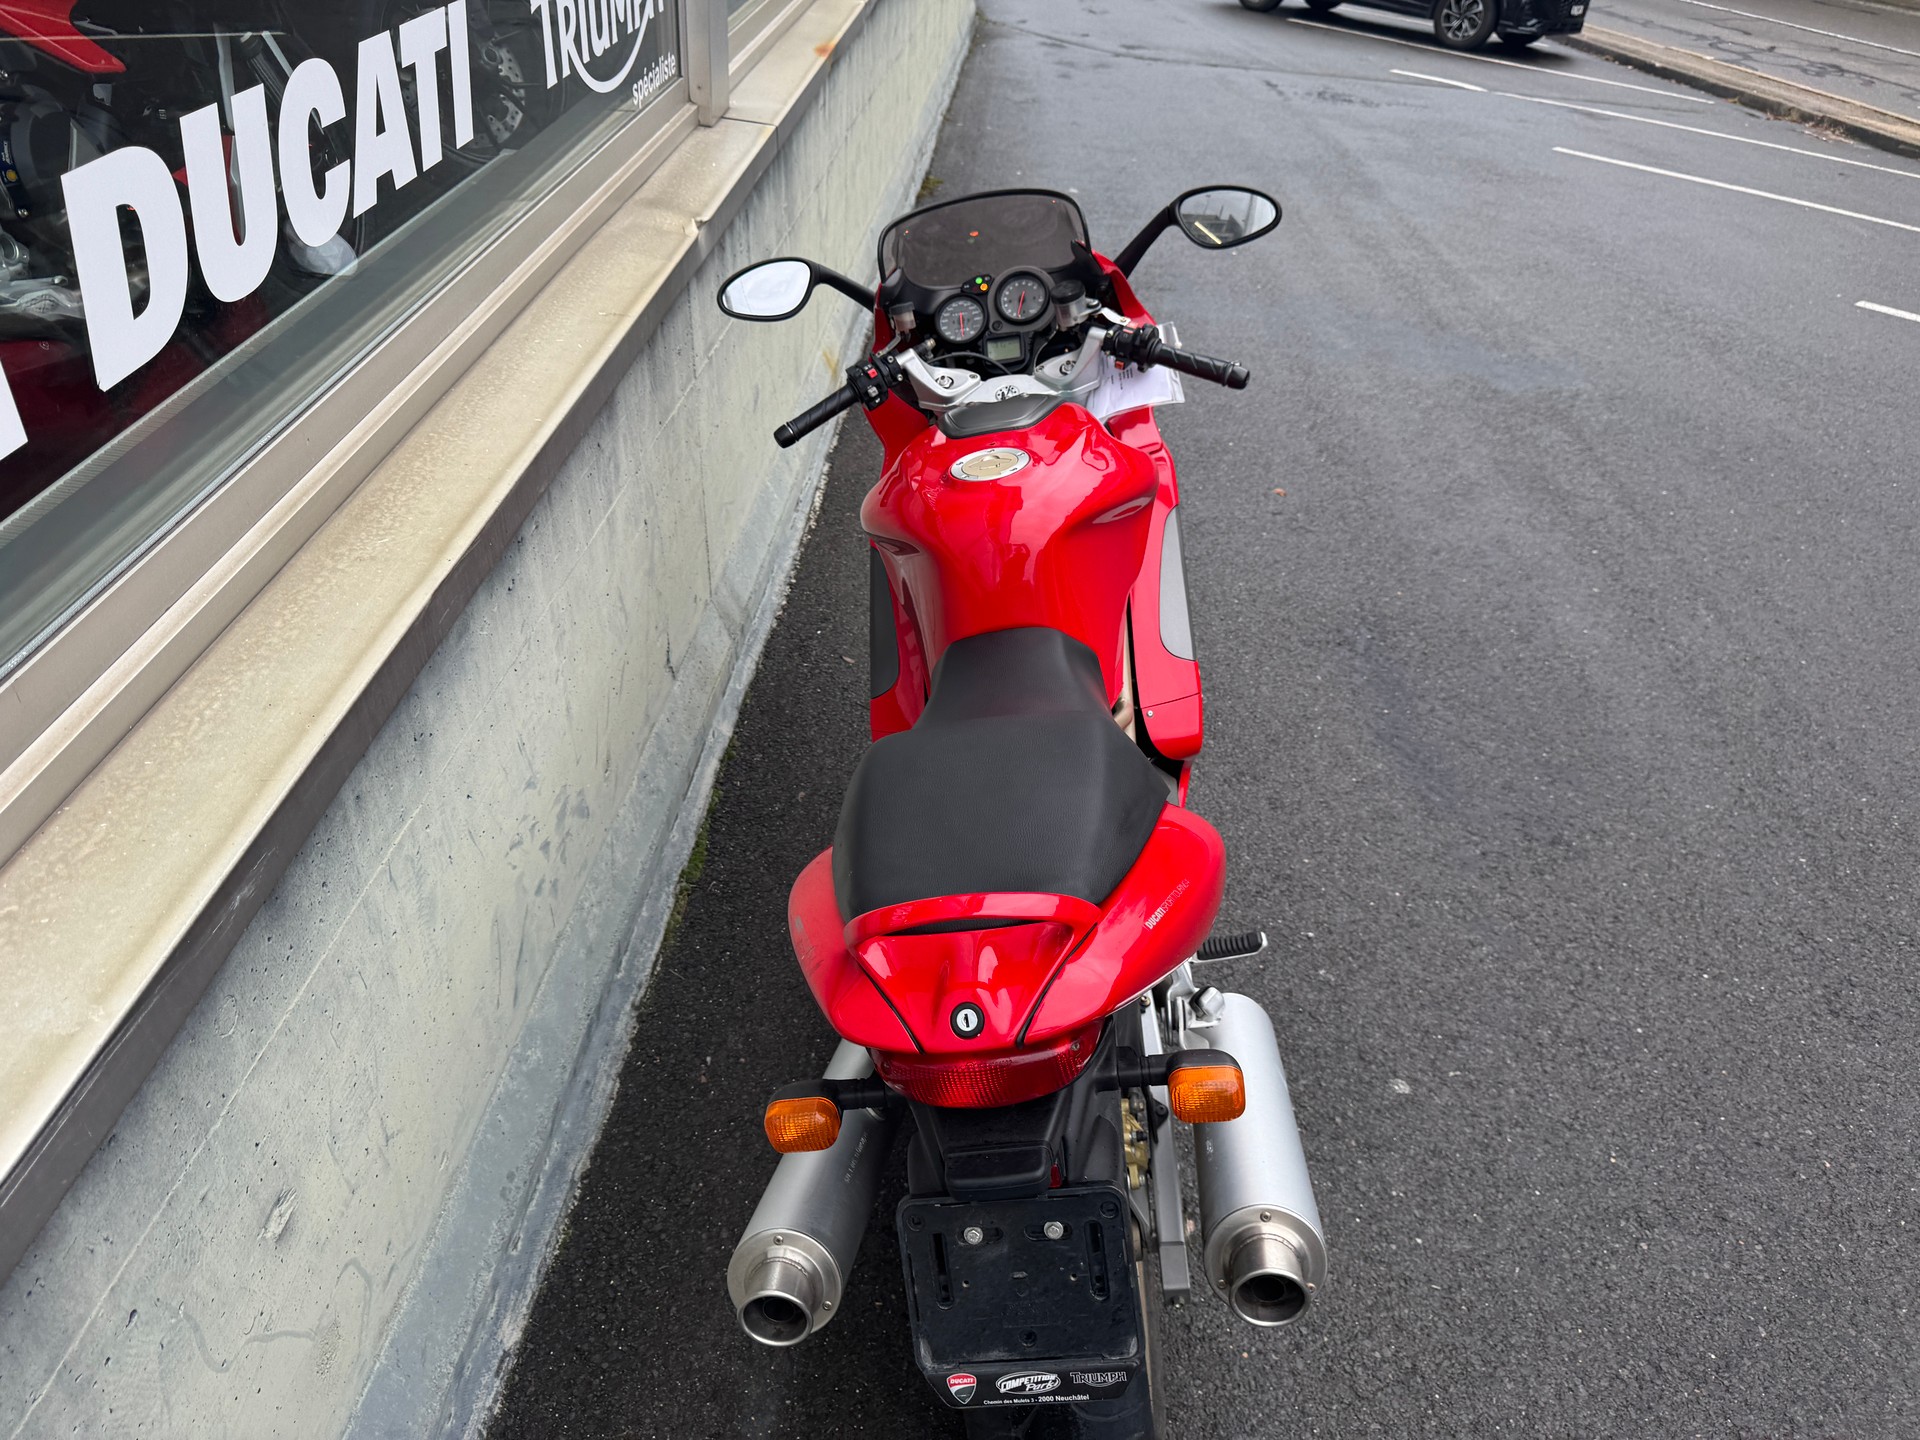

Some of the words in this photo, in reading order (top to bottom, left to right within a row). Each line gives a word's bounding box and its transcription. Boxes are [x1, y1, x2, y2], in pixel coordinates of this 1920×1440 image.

[632, 53, 677, 109] spécialiste
[61, 0, 474, 392] DUCATI
[1000, 1373, 1058, 1393] COMPETITION
[1026, 1380, 1055, 1391] Park
[1070, 1371, 1127, 1387] TRIUMPH
[1038, 1395, 1054, 1403] 2000
